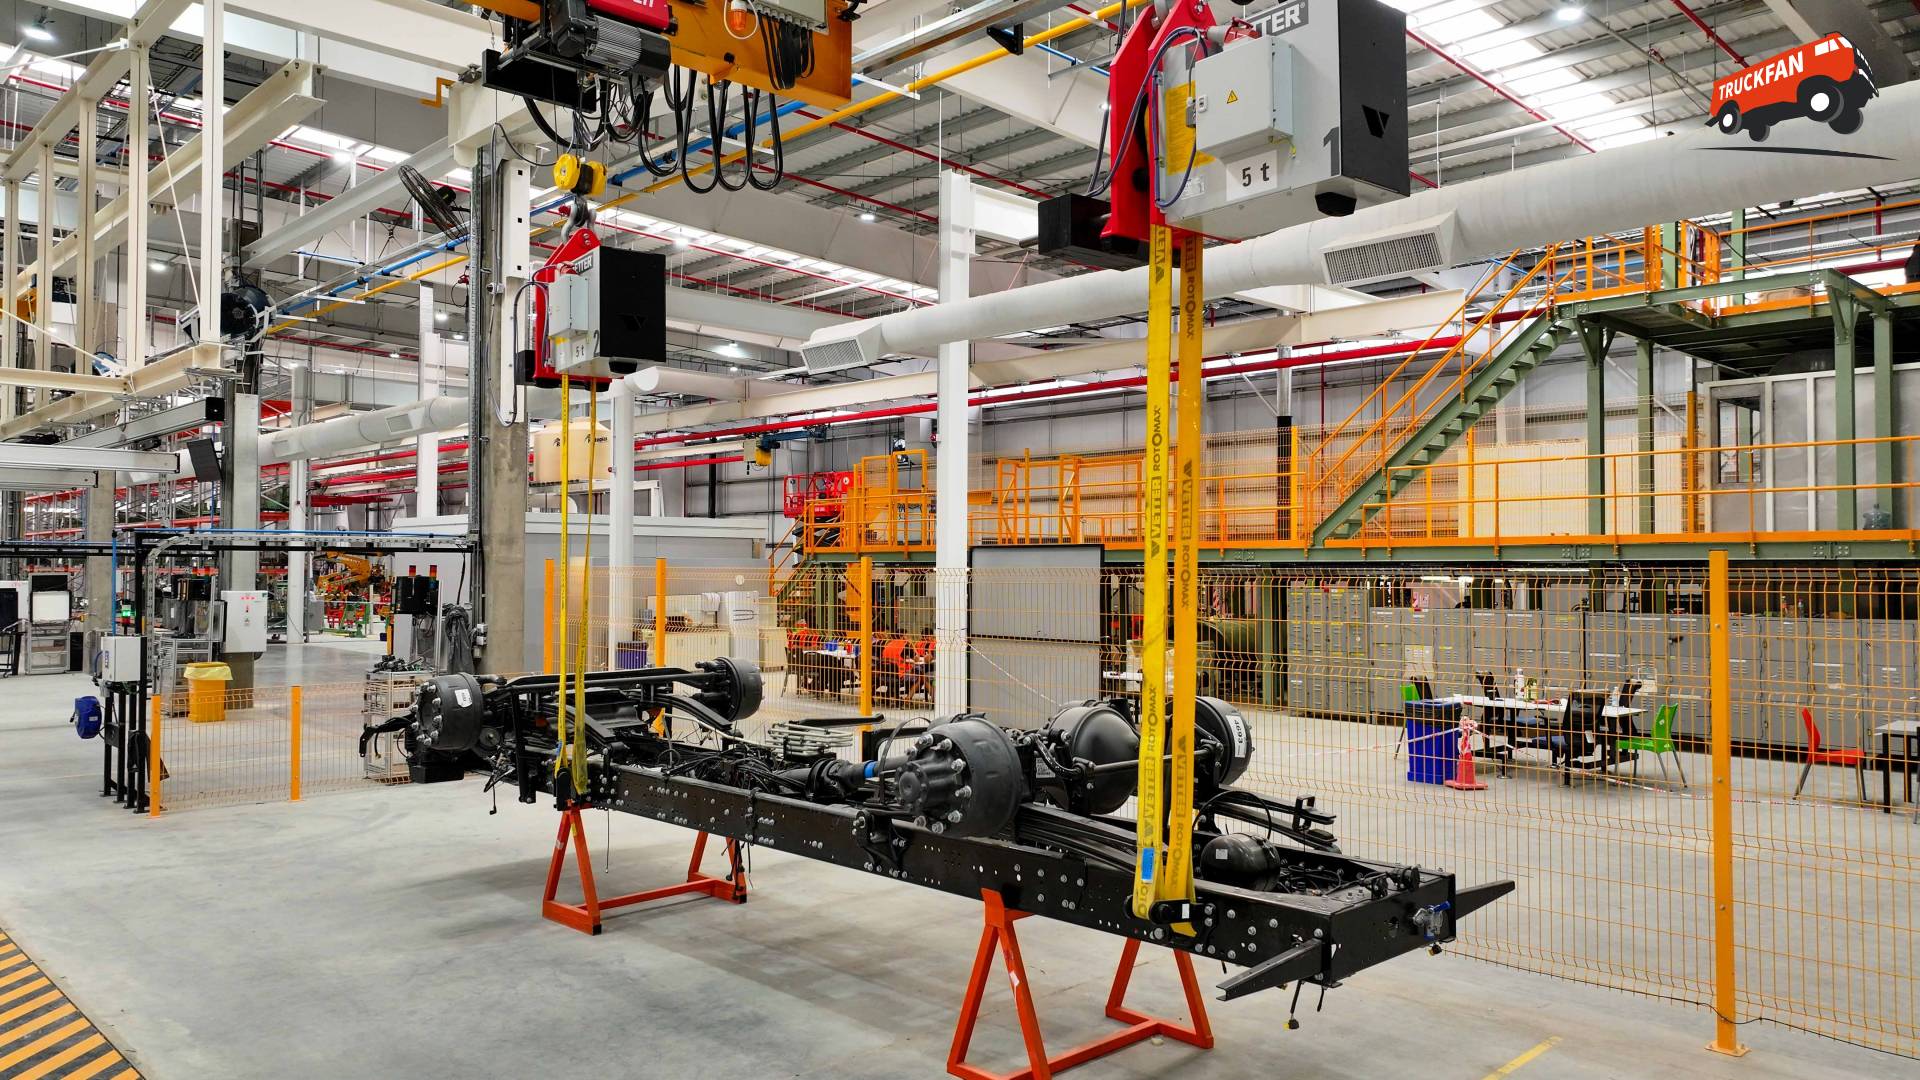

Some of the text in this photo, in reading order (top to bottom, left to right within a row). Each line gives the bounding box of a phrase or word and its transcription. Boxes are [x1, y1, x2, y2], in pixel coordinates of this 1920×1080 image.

[1242, 162, 1270, 187] 5 t
[1184, 276, 1197, 339] ROTOMAX
[1151, 407, 1163, 538] VETTER ROTOMAX
[1181, 480, 1193, 608] VETTER ROTOMAX
[1147, 686, 1158, 752] ROTOMAX
[1234, 719, 1244, 744] 4693
